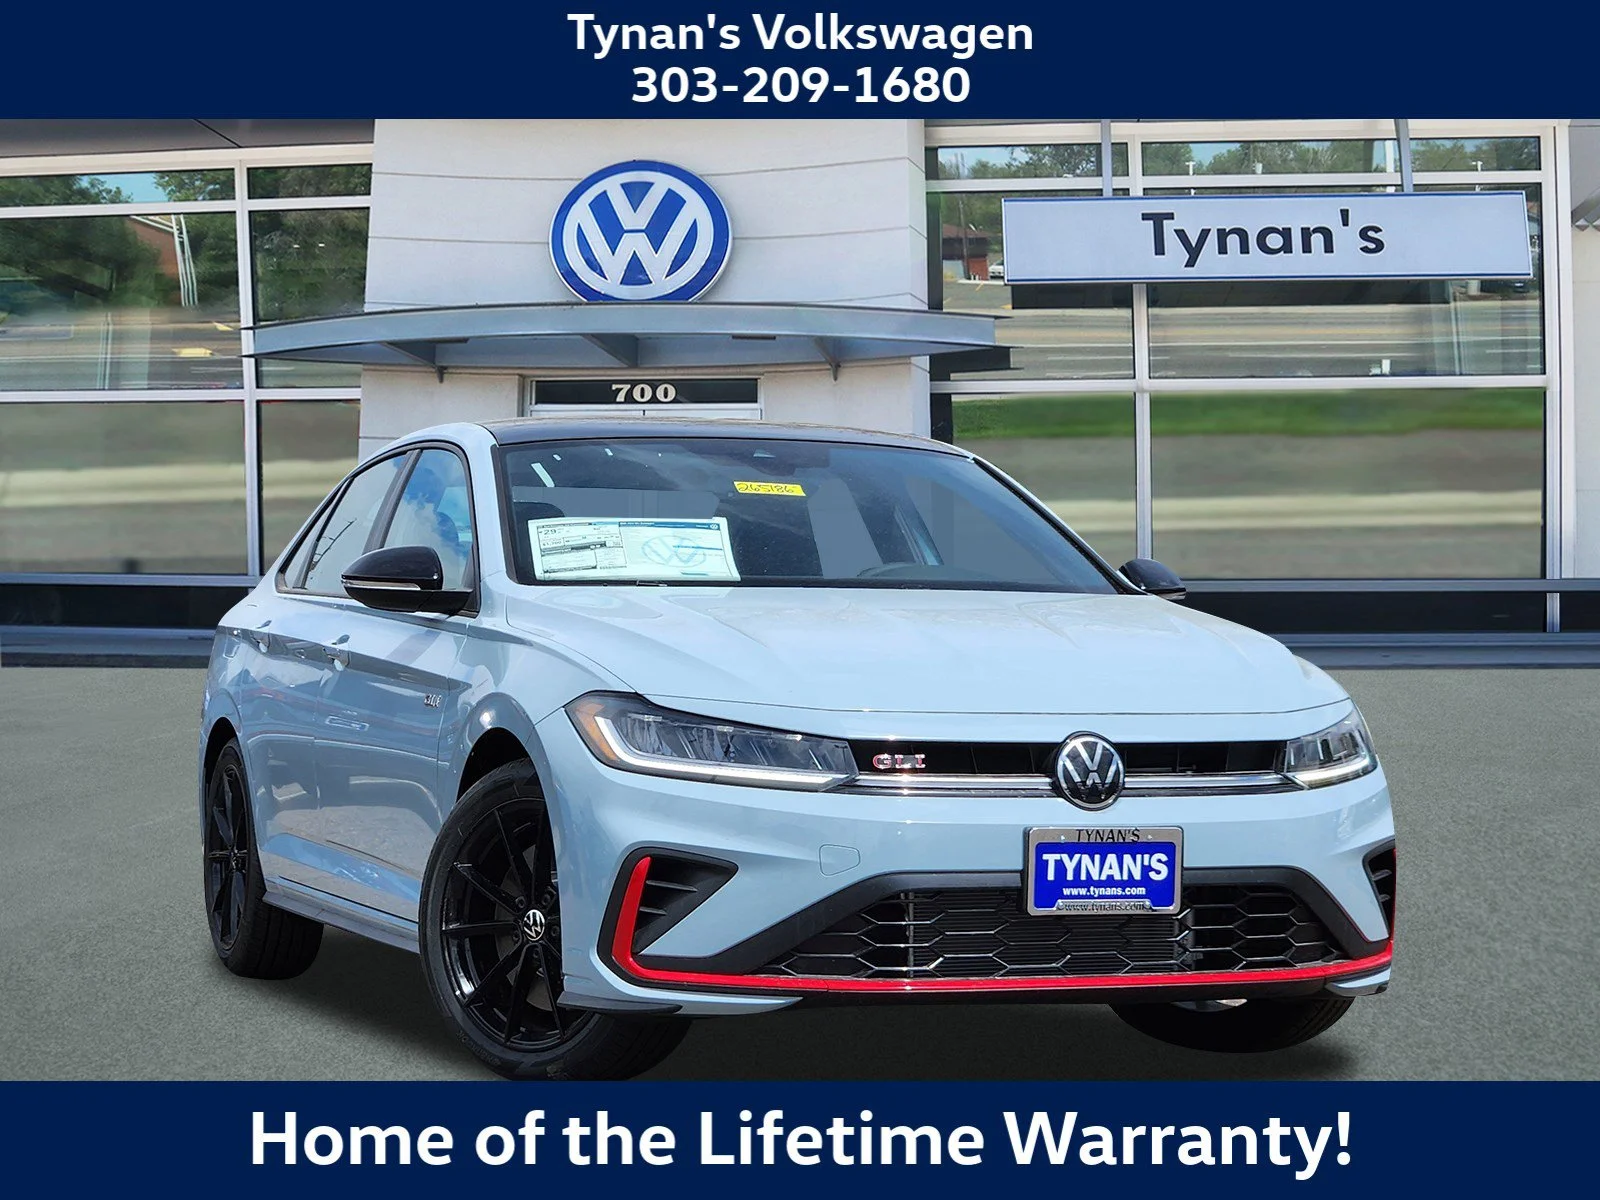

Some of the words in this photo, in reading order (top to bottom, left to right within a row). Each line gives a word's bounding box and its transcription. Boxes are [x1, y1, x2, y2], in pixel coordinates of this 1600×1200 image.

[1141, 208, 1386, 268] Tynan's
[611, 383, 677, 403] 700
[872, 753, 926, 770] GLI
[1076, 828, 1141, 842] TYNAN'S
[1042, 852, 1169, 881] TYNAN'S
[1062, 886, 1146, 896] www.tynans.com
[1062, 901, 1146, 912] www.tynans.com
